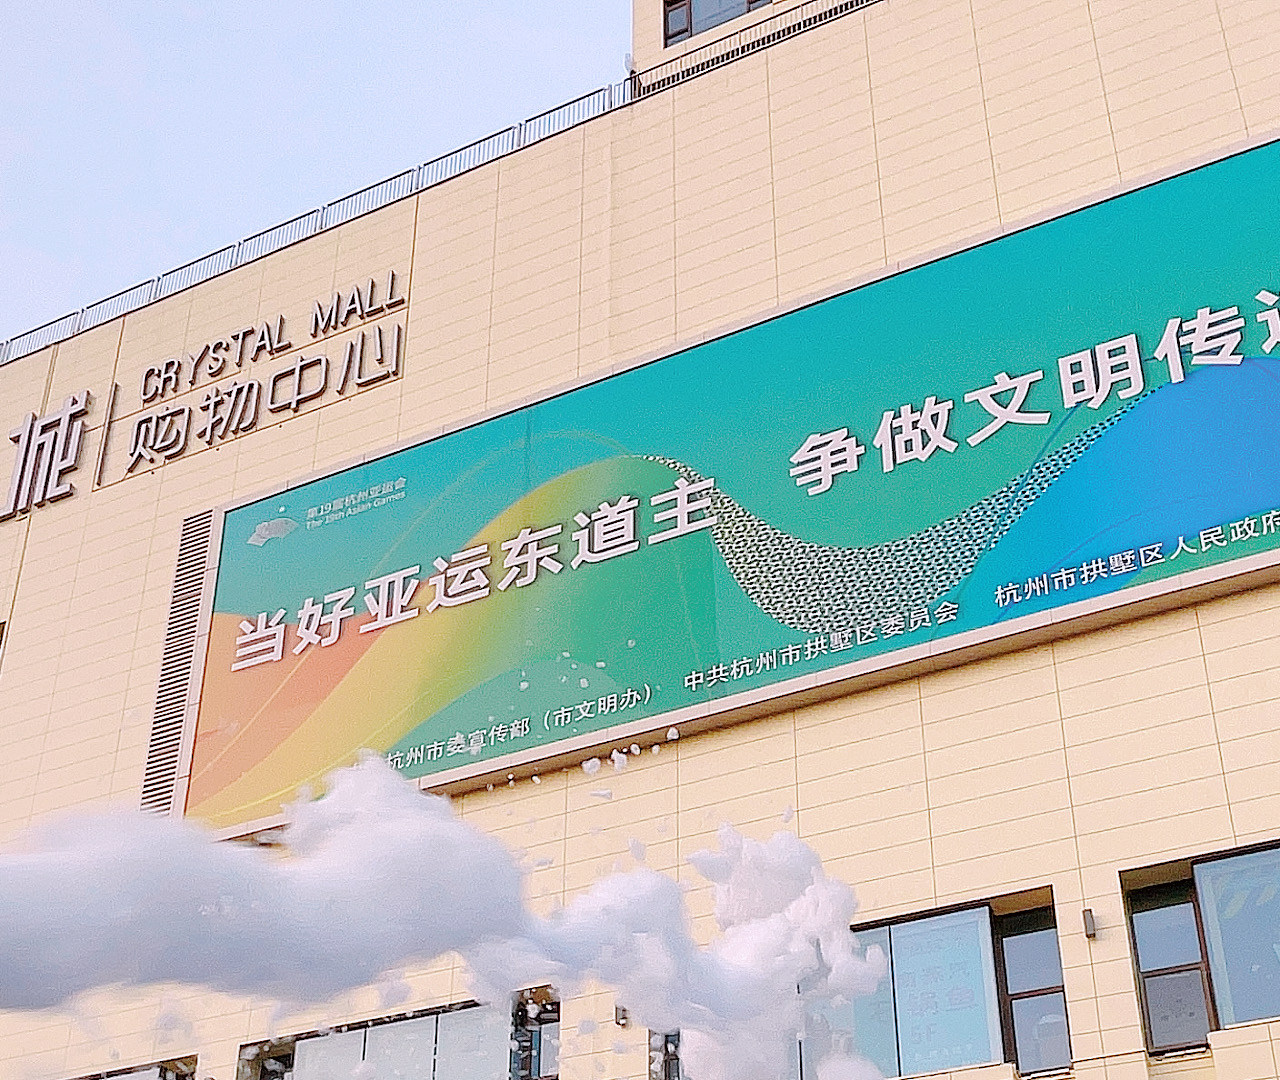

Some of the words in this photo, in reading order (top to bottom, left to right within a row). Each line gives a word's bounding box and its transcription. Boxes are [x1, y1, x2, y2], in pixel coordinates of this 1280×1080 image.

[126, 322, 404, 475] 购物中心
[140, 327, 291, 402] CRYSTAL
[311, 271, 404, 336] MALL
[230, 476, 718, 673] 当好亚运东道主
[684, 600, 959, 692] 中共杭州市拱墅区委员会
